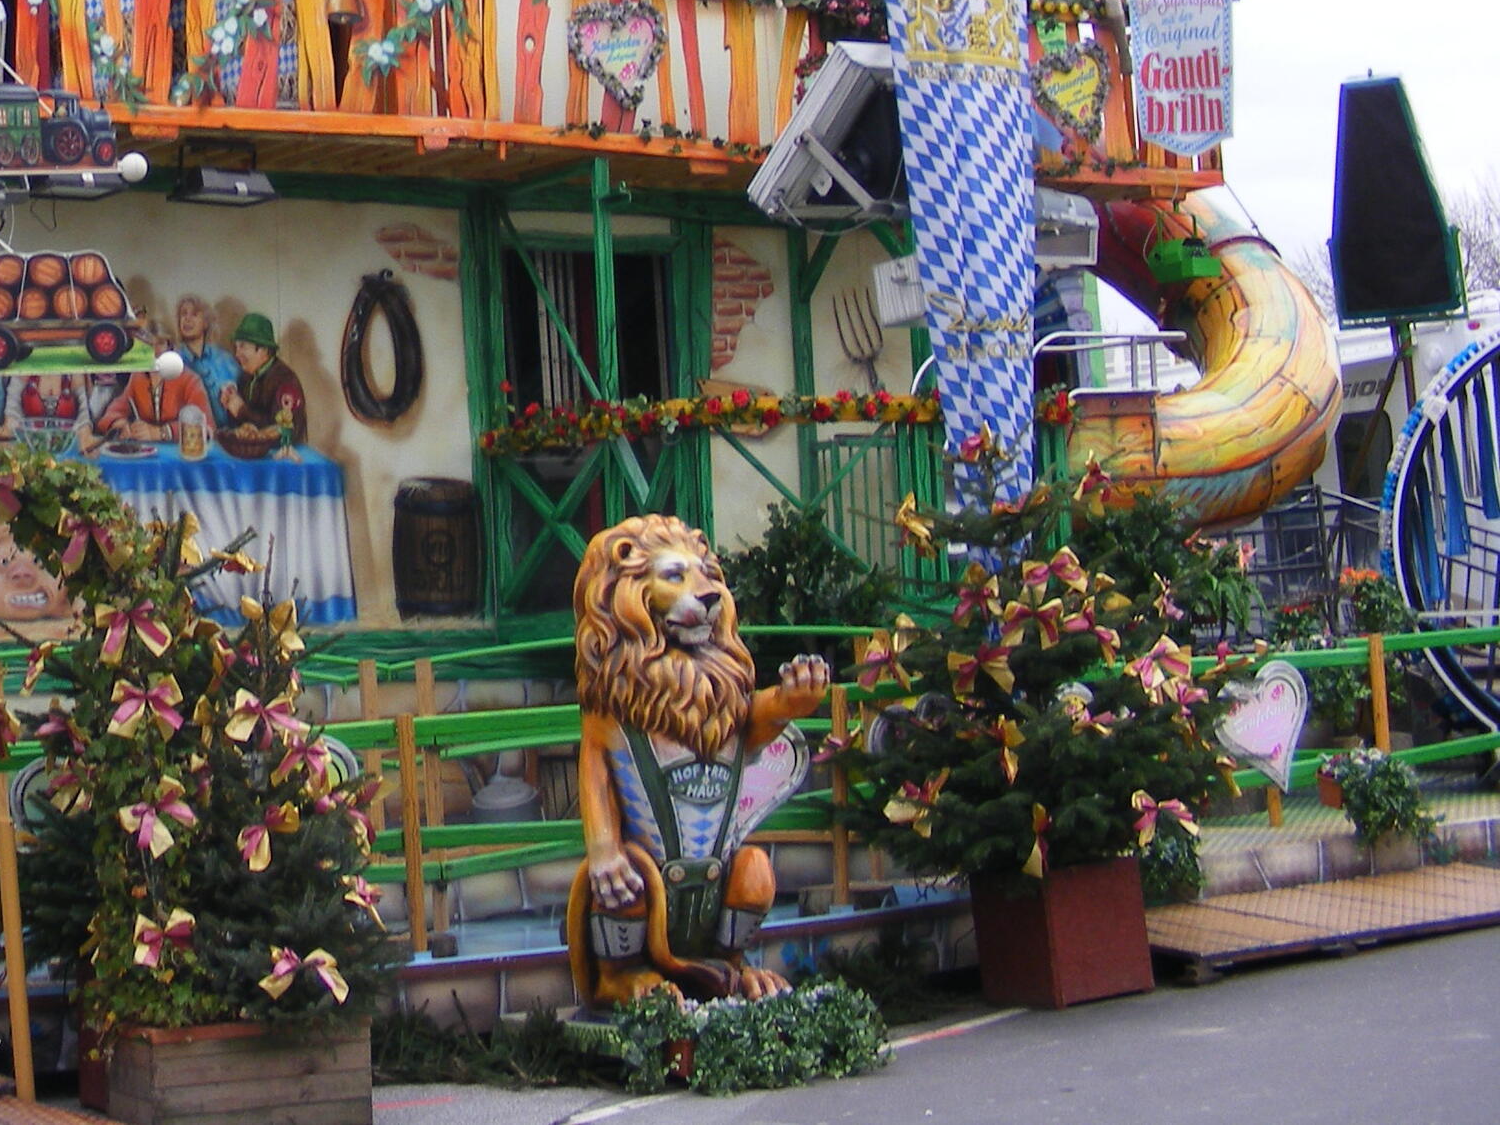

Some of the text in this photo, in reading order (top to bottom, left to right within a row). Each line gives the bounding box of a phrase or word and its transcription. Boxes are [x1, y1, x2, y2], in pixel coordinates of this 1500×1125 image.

[1145, 15, 1220, 50] Original
[671, 764, 700, 784] HOF
[686, 783, 721, 798] HAUS
